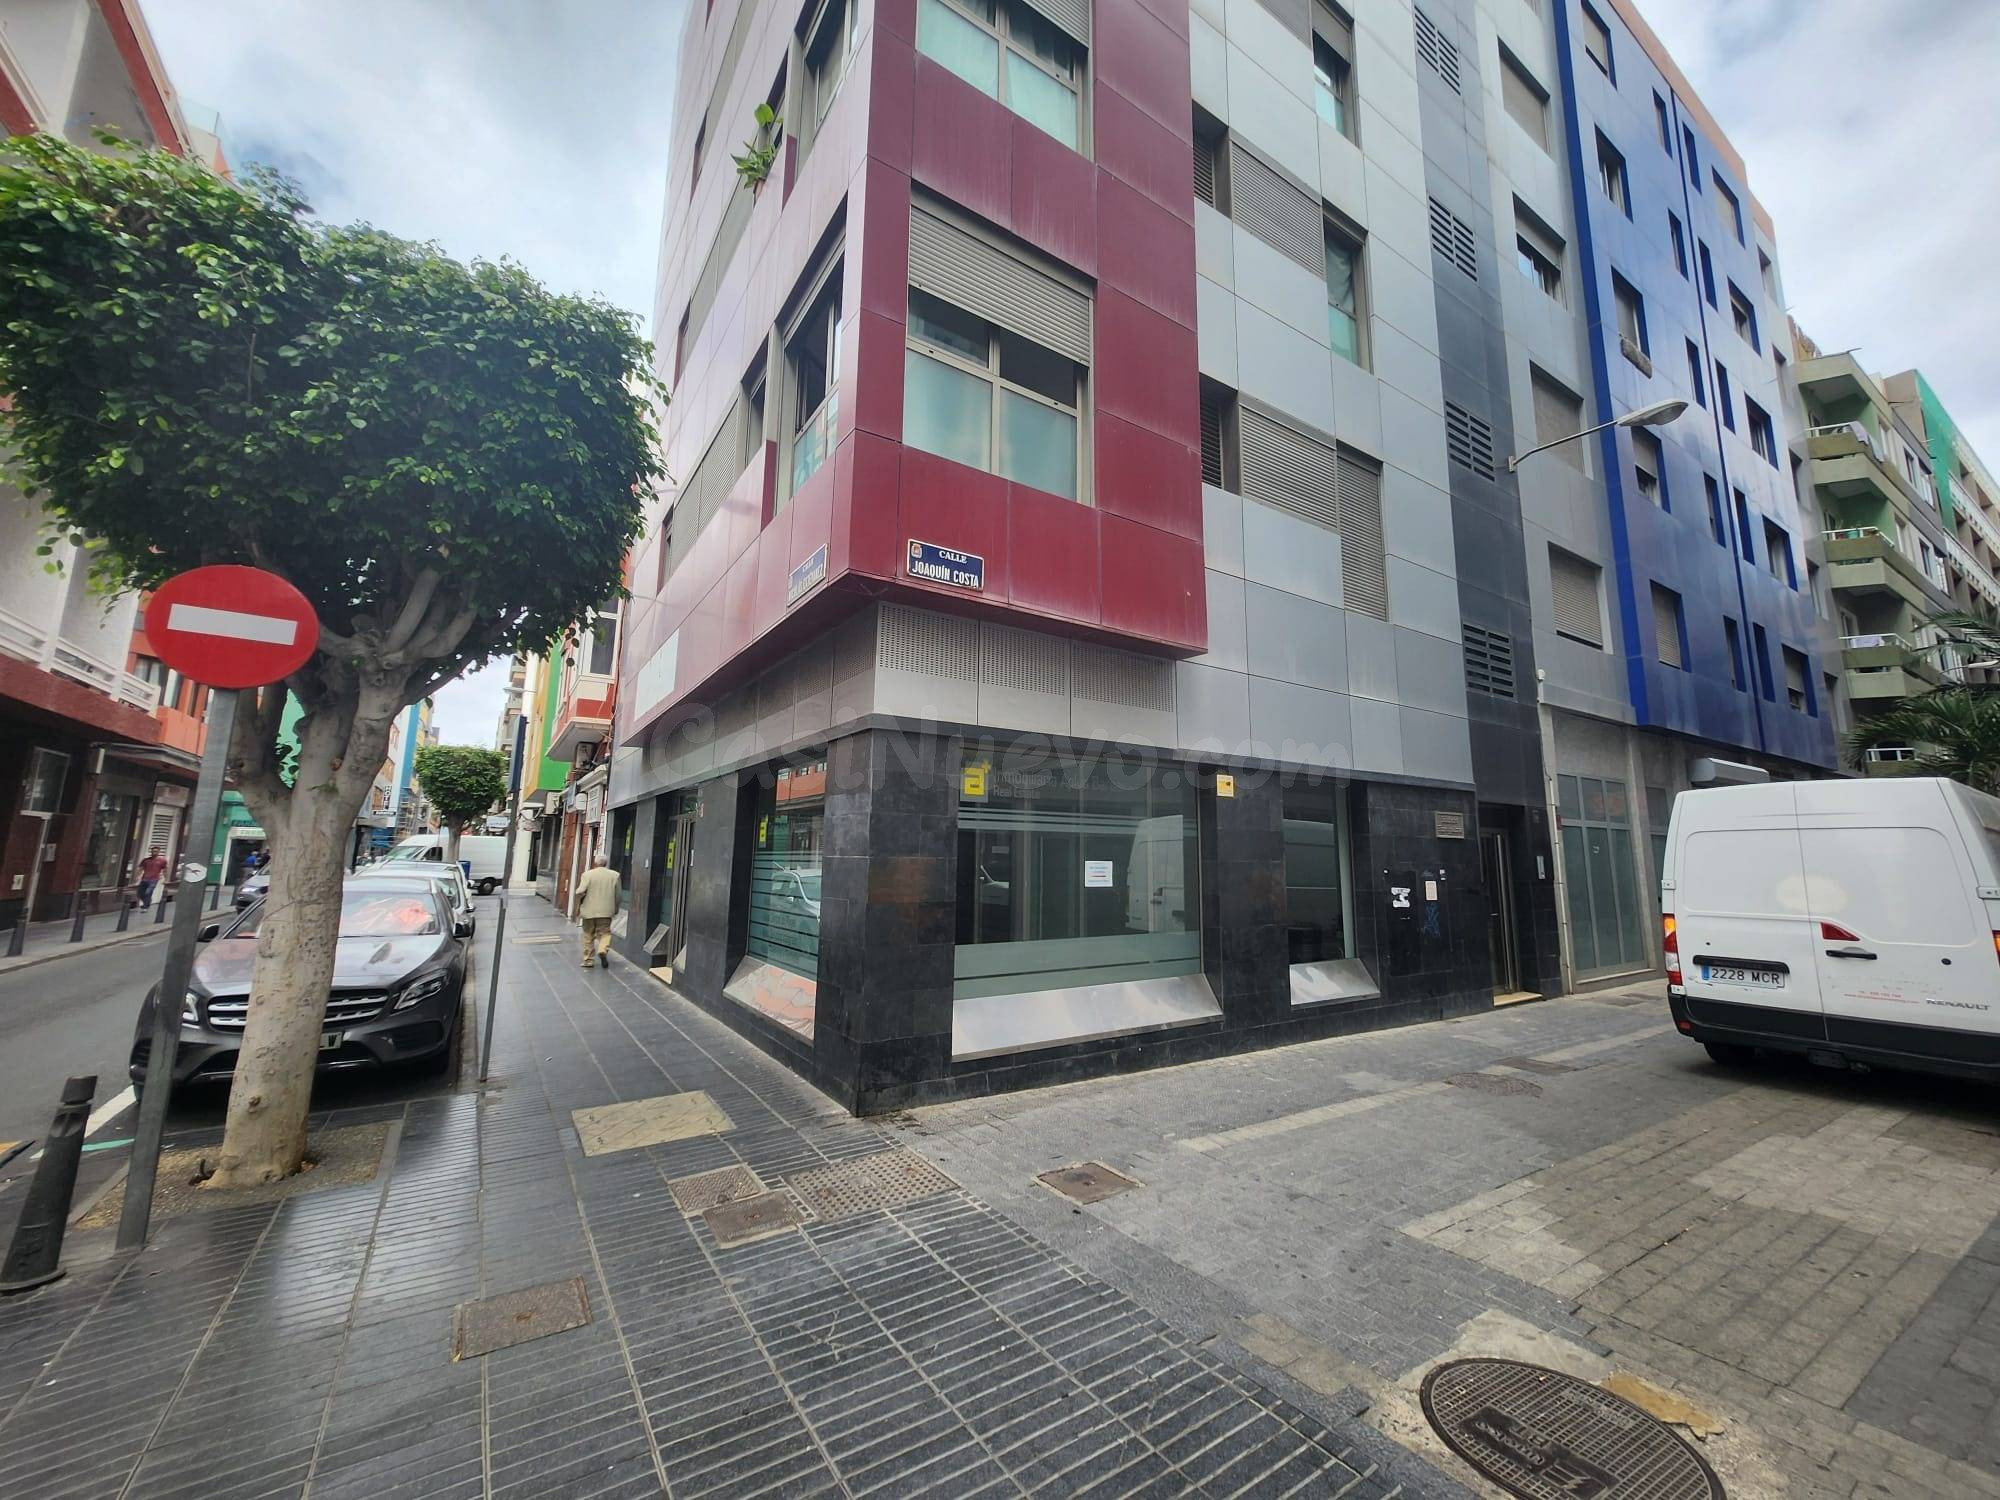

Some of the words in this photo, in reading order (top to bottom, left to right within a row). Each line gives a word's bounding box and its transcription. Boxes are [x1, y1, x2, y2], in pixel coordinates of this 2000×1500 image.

[938, 550, 967, 564] CALLE
[912, 560, 950, 581] JOAQUÍN
[953, 570, 979, 589] COSTA
[1711, 967, 1745, 981] 2228
[1751, 971, 1780, 985] MCR
[1926, 998, 1989, 1011] RENAULT
